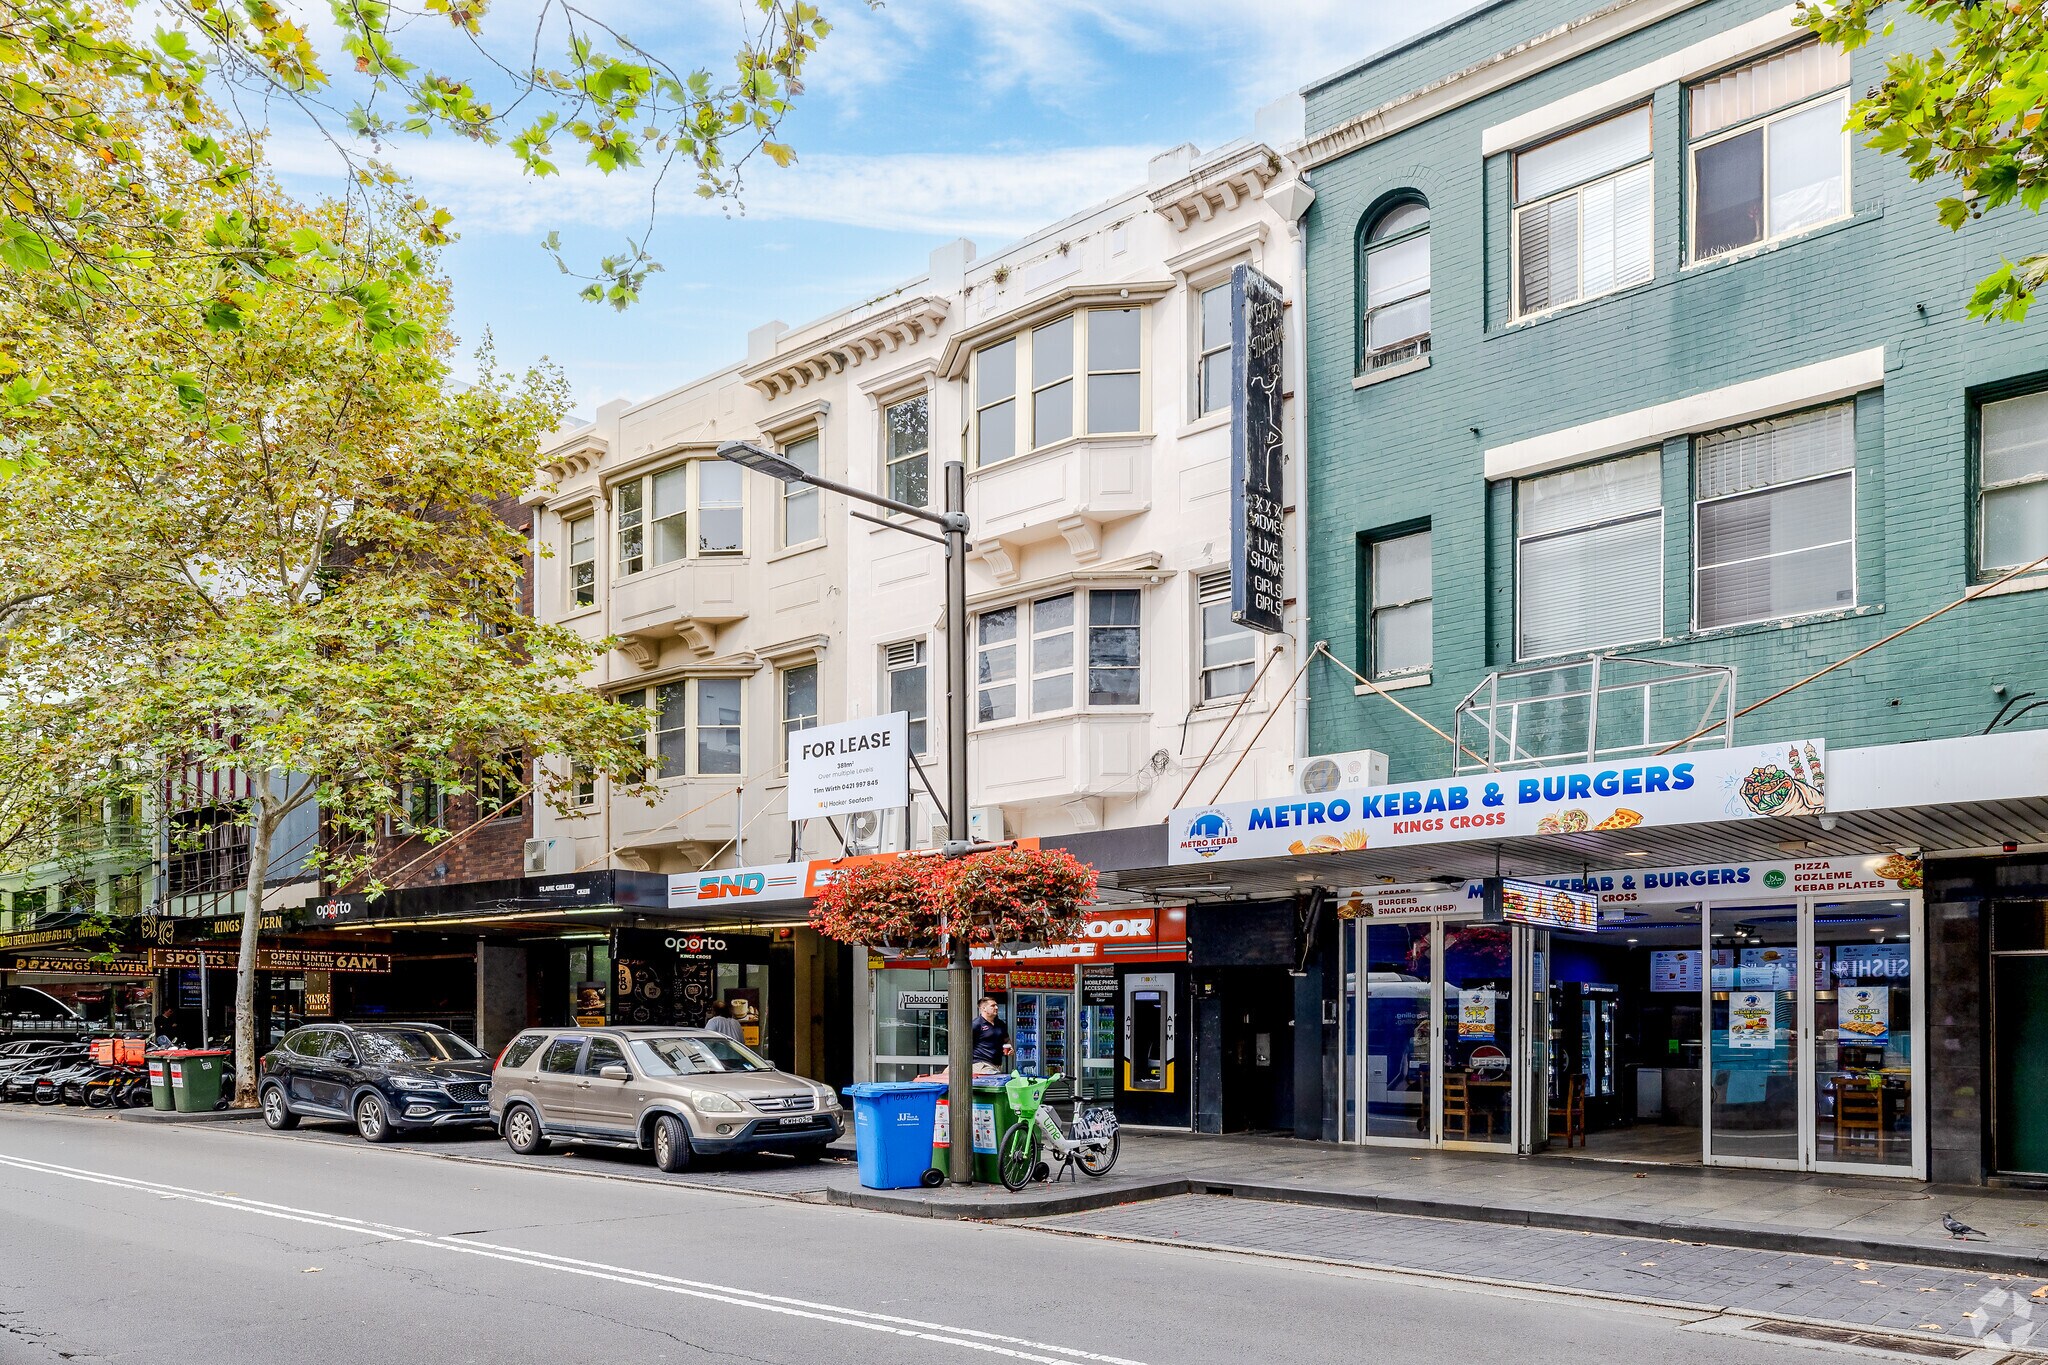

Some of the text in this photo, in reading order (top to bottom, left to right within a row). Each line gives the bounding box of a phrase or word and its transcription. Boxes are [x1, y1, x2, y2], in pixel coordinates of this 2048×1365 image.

[1258, 536, 1279, 559] LIVE
[1251, 550, 1285, 579] SHOWS
[1254, 575, 1282, 599] GIRLS
[1255, 593, 1282, 617] GIRLS
[803, 731, 891, 760] FOR LEASE
[832, 768, 855, 778] multiple
[856, 766, 874, 775] Levels
[1348, 775, 1360, 783] LG
[825, 785, 841, 793] Wirth
[823, 796, 873, 809] LJ Hooker Seaforth
[1248, 763, 1695, 830] METRO KEBAB & BURGERS
[1393, 812, 1506, 835] KINGS CROSS
[1180, 837, 1238, 848] METRO KEBAB
[1794, 862, 1830, 871] PIZZA
[1622, 875, 1636, 890] &
[1644, 867, 1751, 889] BURGERS
[1794, 871, 1852, 881] GOZLEME
[697, 873, 765, 899] SND
[1794, 881, 1885, 892] KEBAB PLATES
[1378, 898, 1417, 906] BURGERS
[1601, 893, 1638, 903] CROSS
[316, 901, 351, 919] oporto
[1378, 907, 1407, 915] SNACK
[1433, 904, 1457, 913] (HSP)
[214, 916, 282, 933] KINGS VERN
[1083, 918, 1152, 938] OOR
[270, 952, 334, 963] OPEN UNTIL
[336, 956, 377, 969] 6AM
[103, 962, 153, 972] TAVERN
[904, 994, 948, 1004] Tobacconis
[1465, 1010, 1486, 1021] $12
[1854, 1014, 1873, 1022] $12
